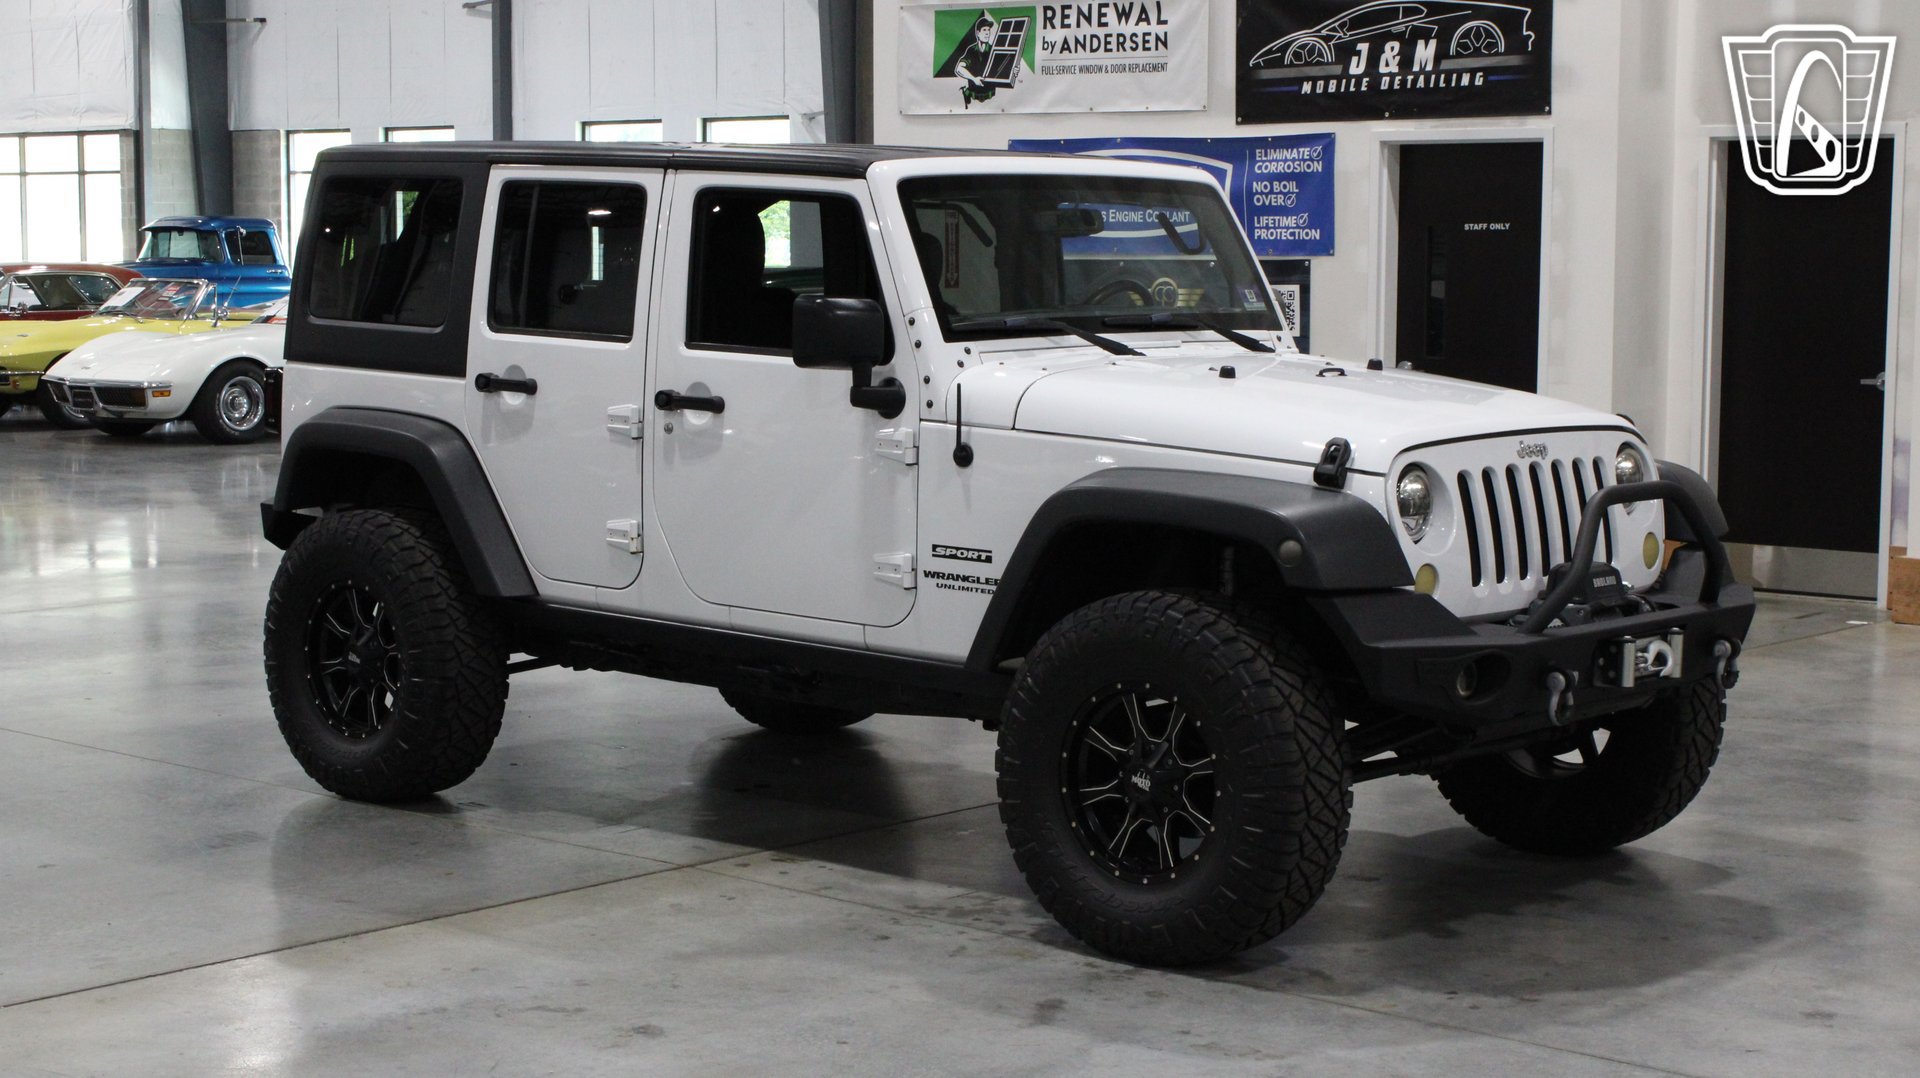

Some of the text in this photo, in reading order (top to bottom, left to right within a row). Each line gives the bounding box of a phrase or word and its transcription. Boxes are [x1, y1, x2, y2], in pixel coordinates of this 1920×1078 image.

[1042, 1, 1169, 30] RENEWAL
[1042, 31, 1169, 54] by ANDERSEN
[1348, 38, 1438, 75] J & M
[1041, 62, 1168, 76] FULL-SERVICE WINDOW & DOOR REPLACEMENT
[1301, 72, 1484, 95] MOBILE DETAILING
[1255, 147, 1310, 161] ELIMINATE
[1254, 161, 1322, 174] CORROSION
[1252, 180, 1299, 193] NO BOIL
[1253, 194, 1285, 206] OVER
[1109, 209, 1144, 222] ENGINE
[1145, 209, 1190, 222] COLANT
[1254, 215, 1297, 227] LIFETIME
[1464, 222, 1511, 231] STAFF ONLY
[1254, 228, 1320, 240] PROTECTION
[1516, 440, 1548, 460] Jeep
[934, 546, 992, 561] SPORT
[936, 582, 995, 595] UNLIMITED
